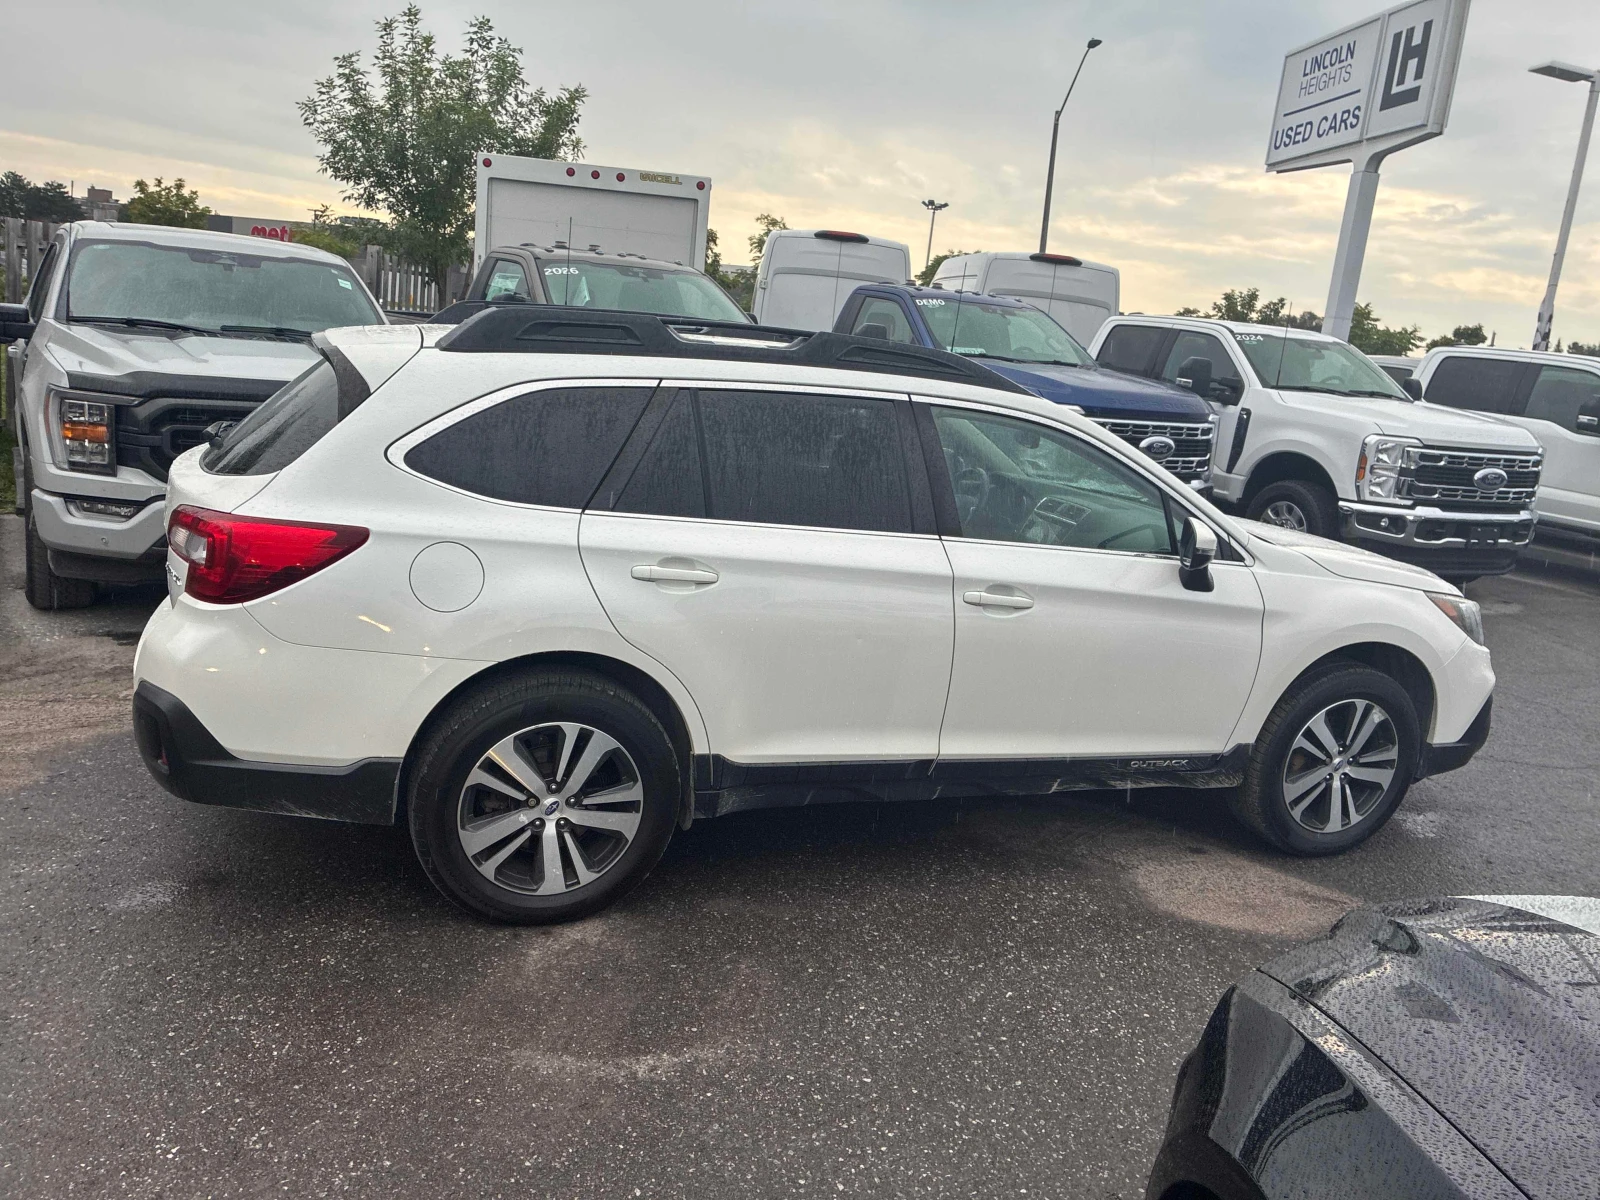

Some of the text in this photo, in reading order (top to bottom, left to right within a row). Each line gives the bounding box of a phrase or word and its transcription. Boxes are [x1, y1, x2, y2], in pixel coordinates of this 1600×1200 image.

[1302, 40, 1356, 77] LINCOLN
[1298, 64, 1352, 98] HEIGHTS
[1273, 105, 1361, 150] USED CARS
[543, 267, 579, 276] 2026
[1130, 760, 1189, 768] OUTBACK
